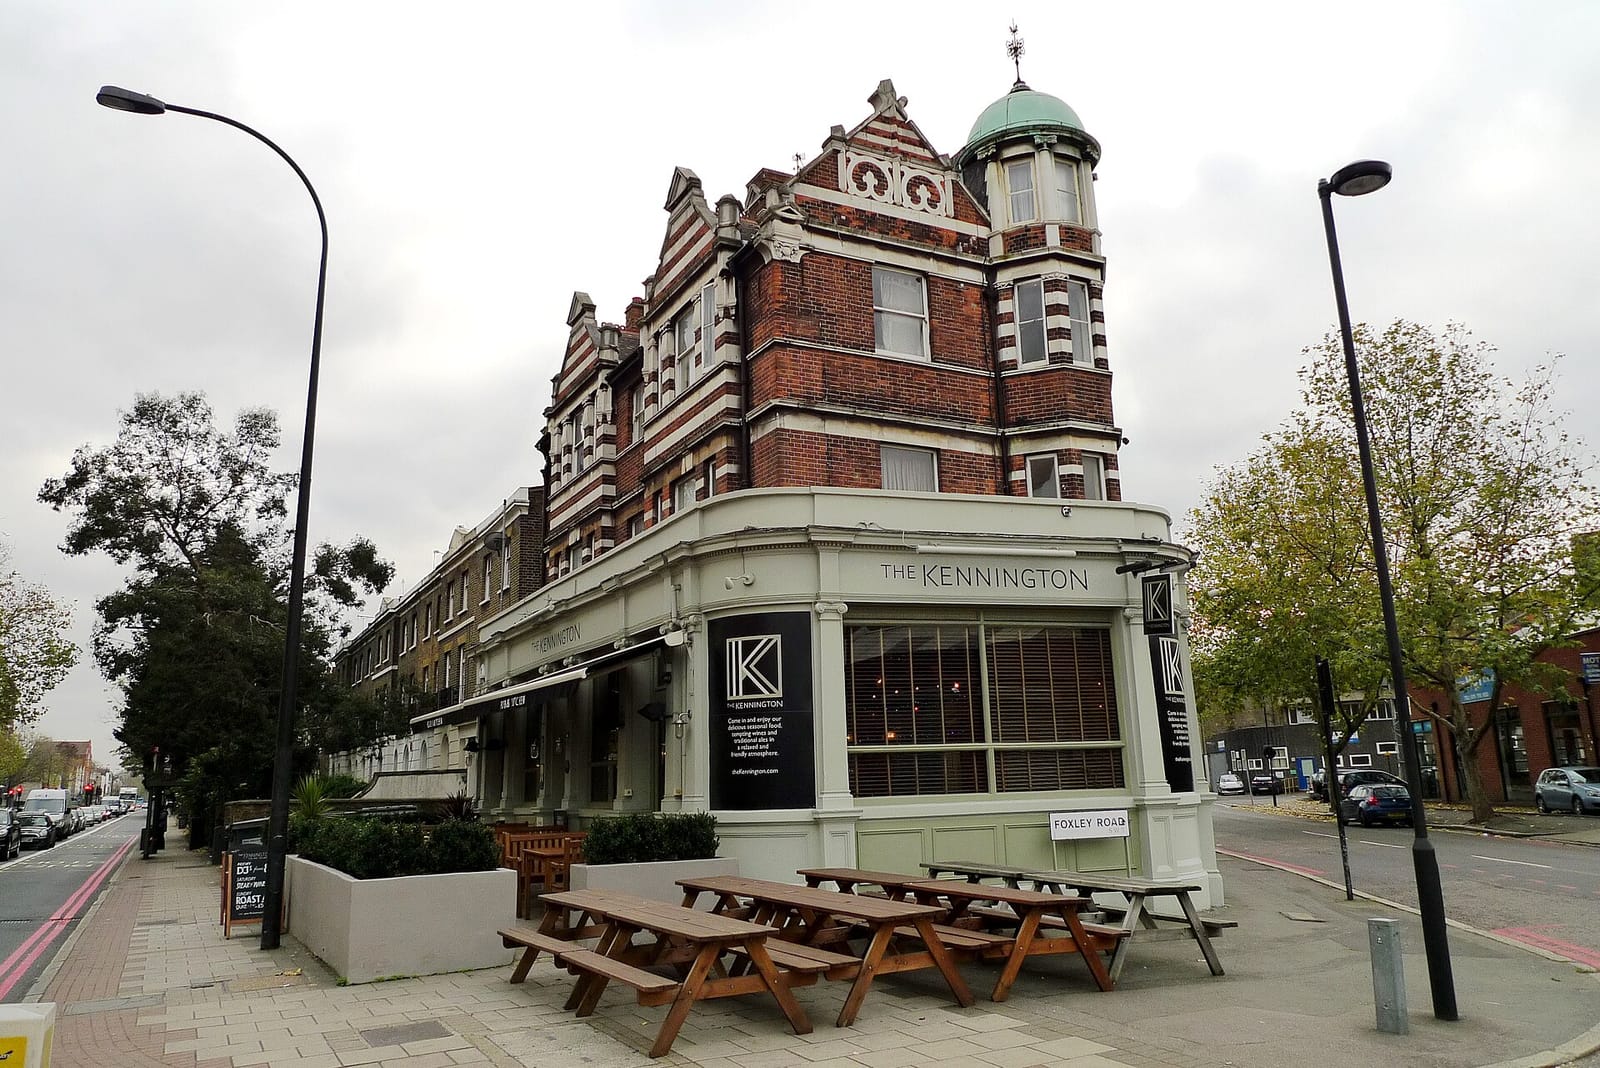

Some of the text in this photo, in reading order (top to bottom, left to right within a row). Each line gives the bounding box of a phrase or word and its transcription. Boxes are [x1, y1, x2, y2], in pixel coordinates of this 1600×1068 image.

[880, 564, 1089, 591] THE KENNINGTON
[540, 624, 581, 654] KENNINGTON
[735, 700, 784, 710] KENNINGTON
[1054, 817, 1126, 829] FOXLEY ROAD
